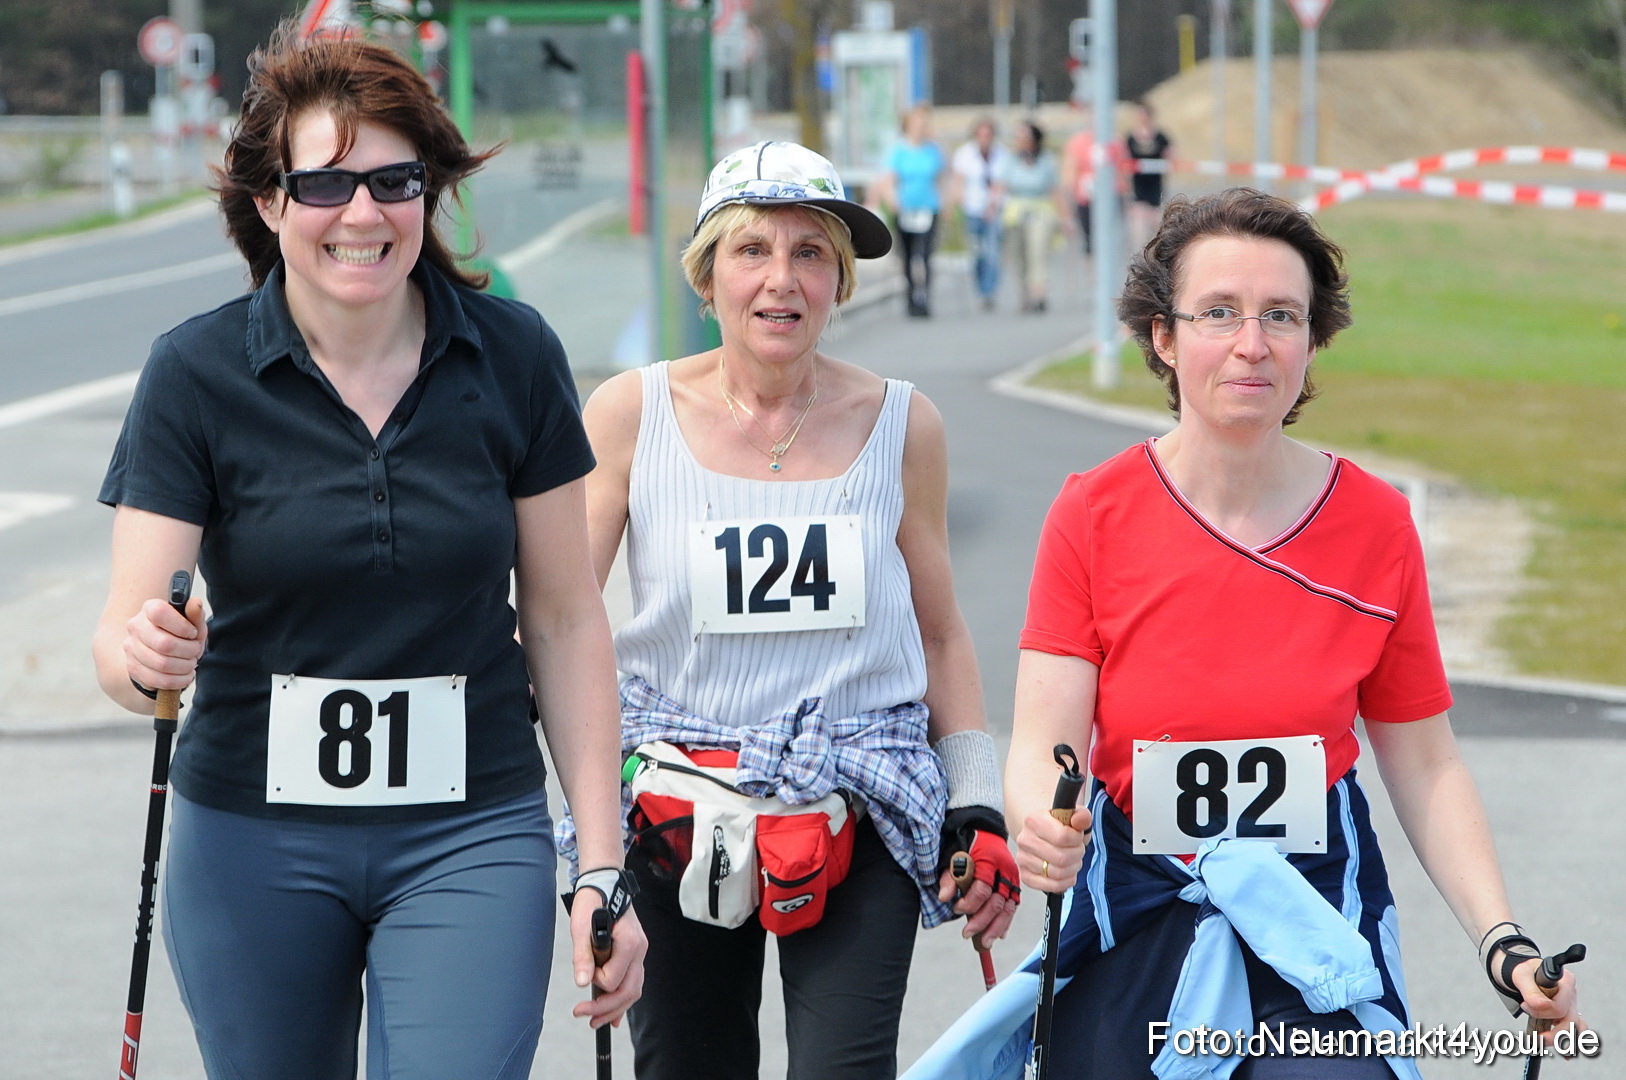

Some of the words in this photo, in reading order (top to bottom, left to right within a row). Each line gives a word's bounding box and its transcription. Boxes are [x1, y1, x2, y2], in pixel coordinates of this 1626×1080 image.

[715, 523, 836, 614] 124
[318, 689, 410, 789] 81
[1177, 747, 1287, 839] 82
[611, 887, 626, 914] LEKI
